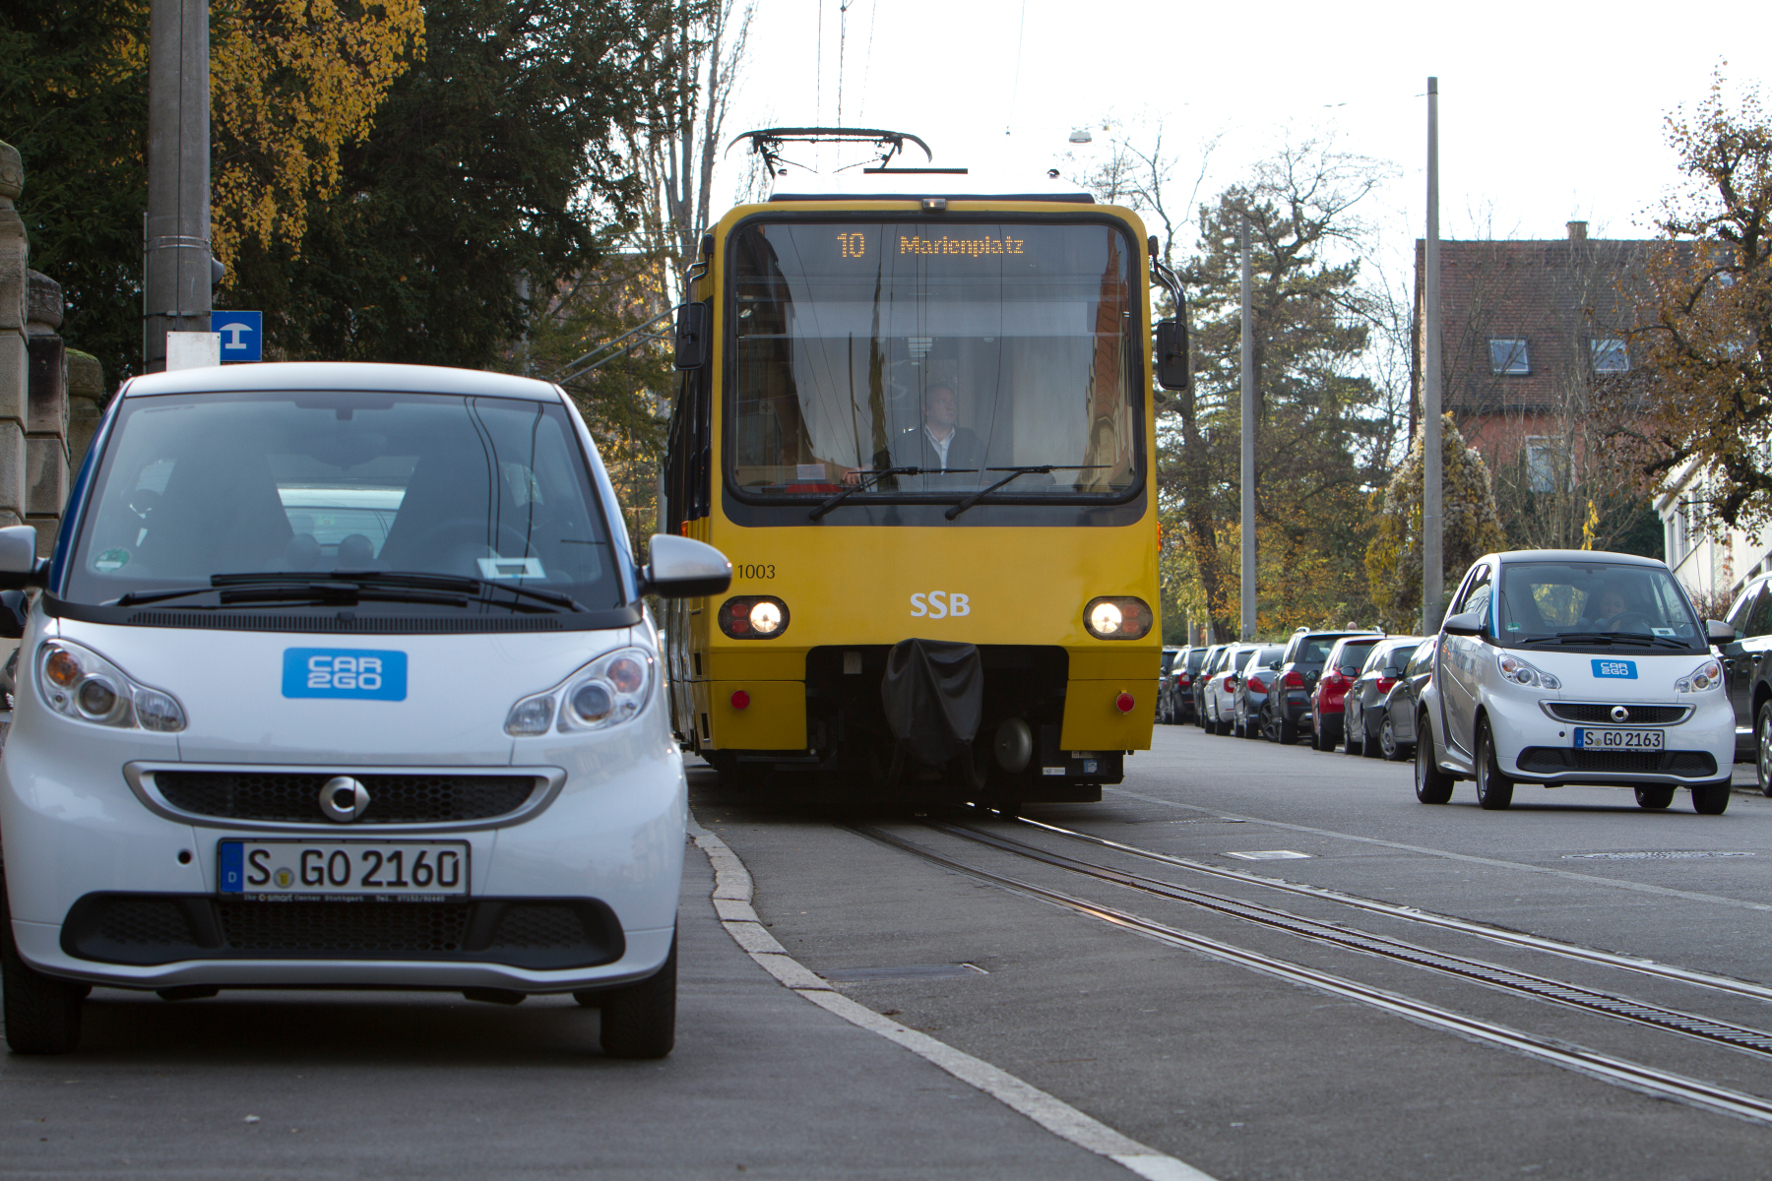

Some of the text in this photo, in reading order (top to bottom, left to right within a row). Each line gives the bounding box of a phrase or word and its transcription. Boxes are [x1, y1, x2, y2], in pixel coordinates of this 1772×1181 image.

[836, 232, 1024, 258] 10 Marienplatz
[737, 564, 776, 580] 1003
[909, 590, 971, 620] SSB
[308, 656, 382, 673] CAR
[307, 672, 382, 690] 2GO
[1584, 731, 1661, 747] S GO 2163
[227, 871, 238, 883] D
[247, 849, 460, 888] S GO 2160
[267, 893, 293, 902] smart
[294, 894, 321, 902] Center
[325, 894, 364, 903] Stuttgart
